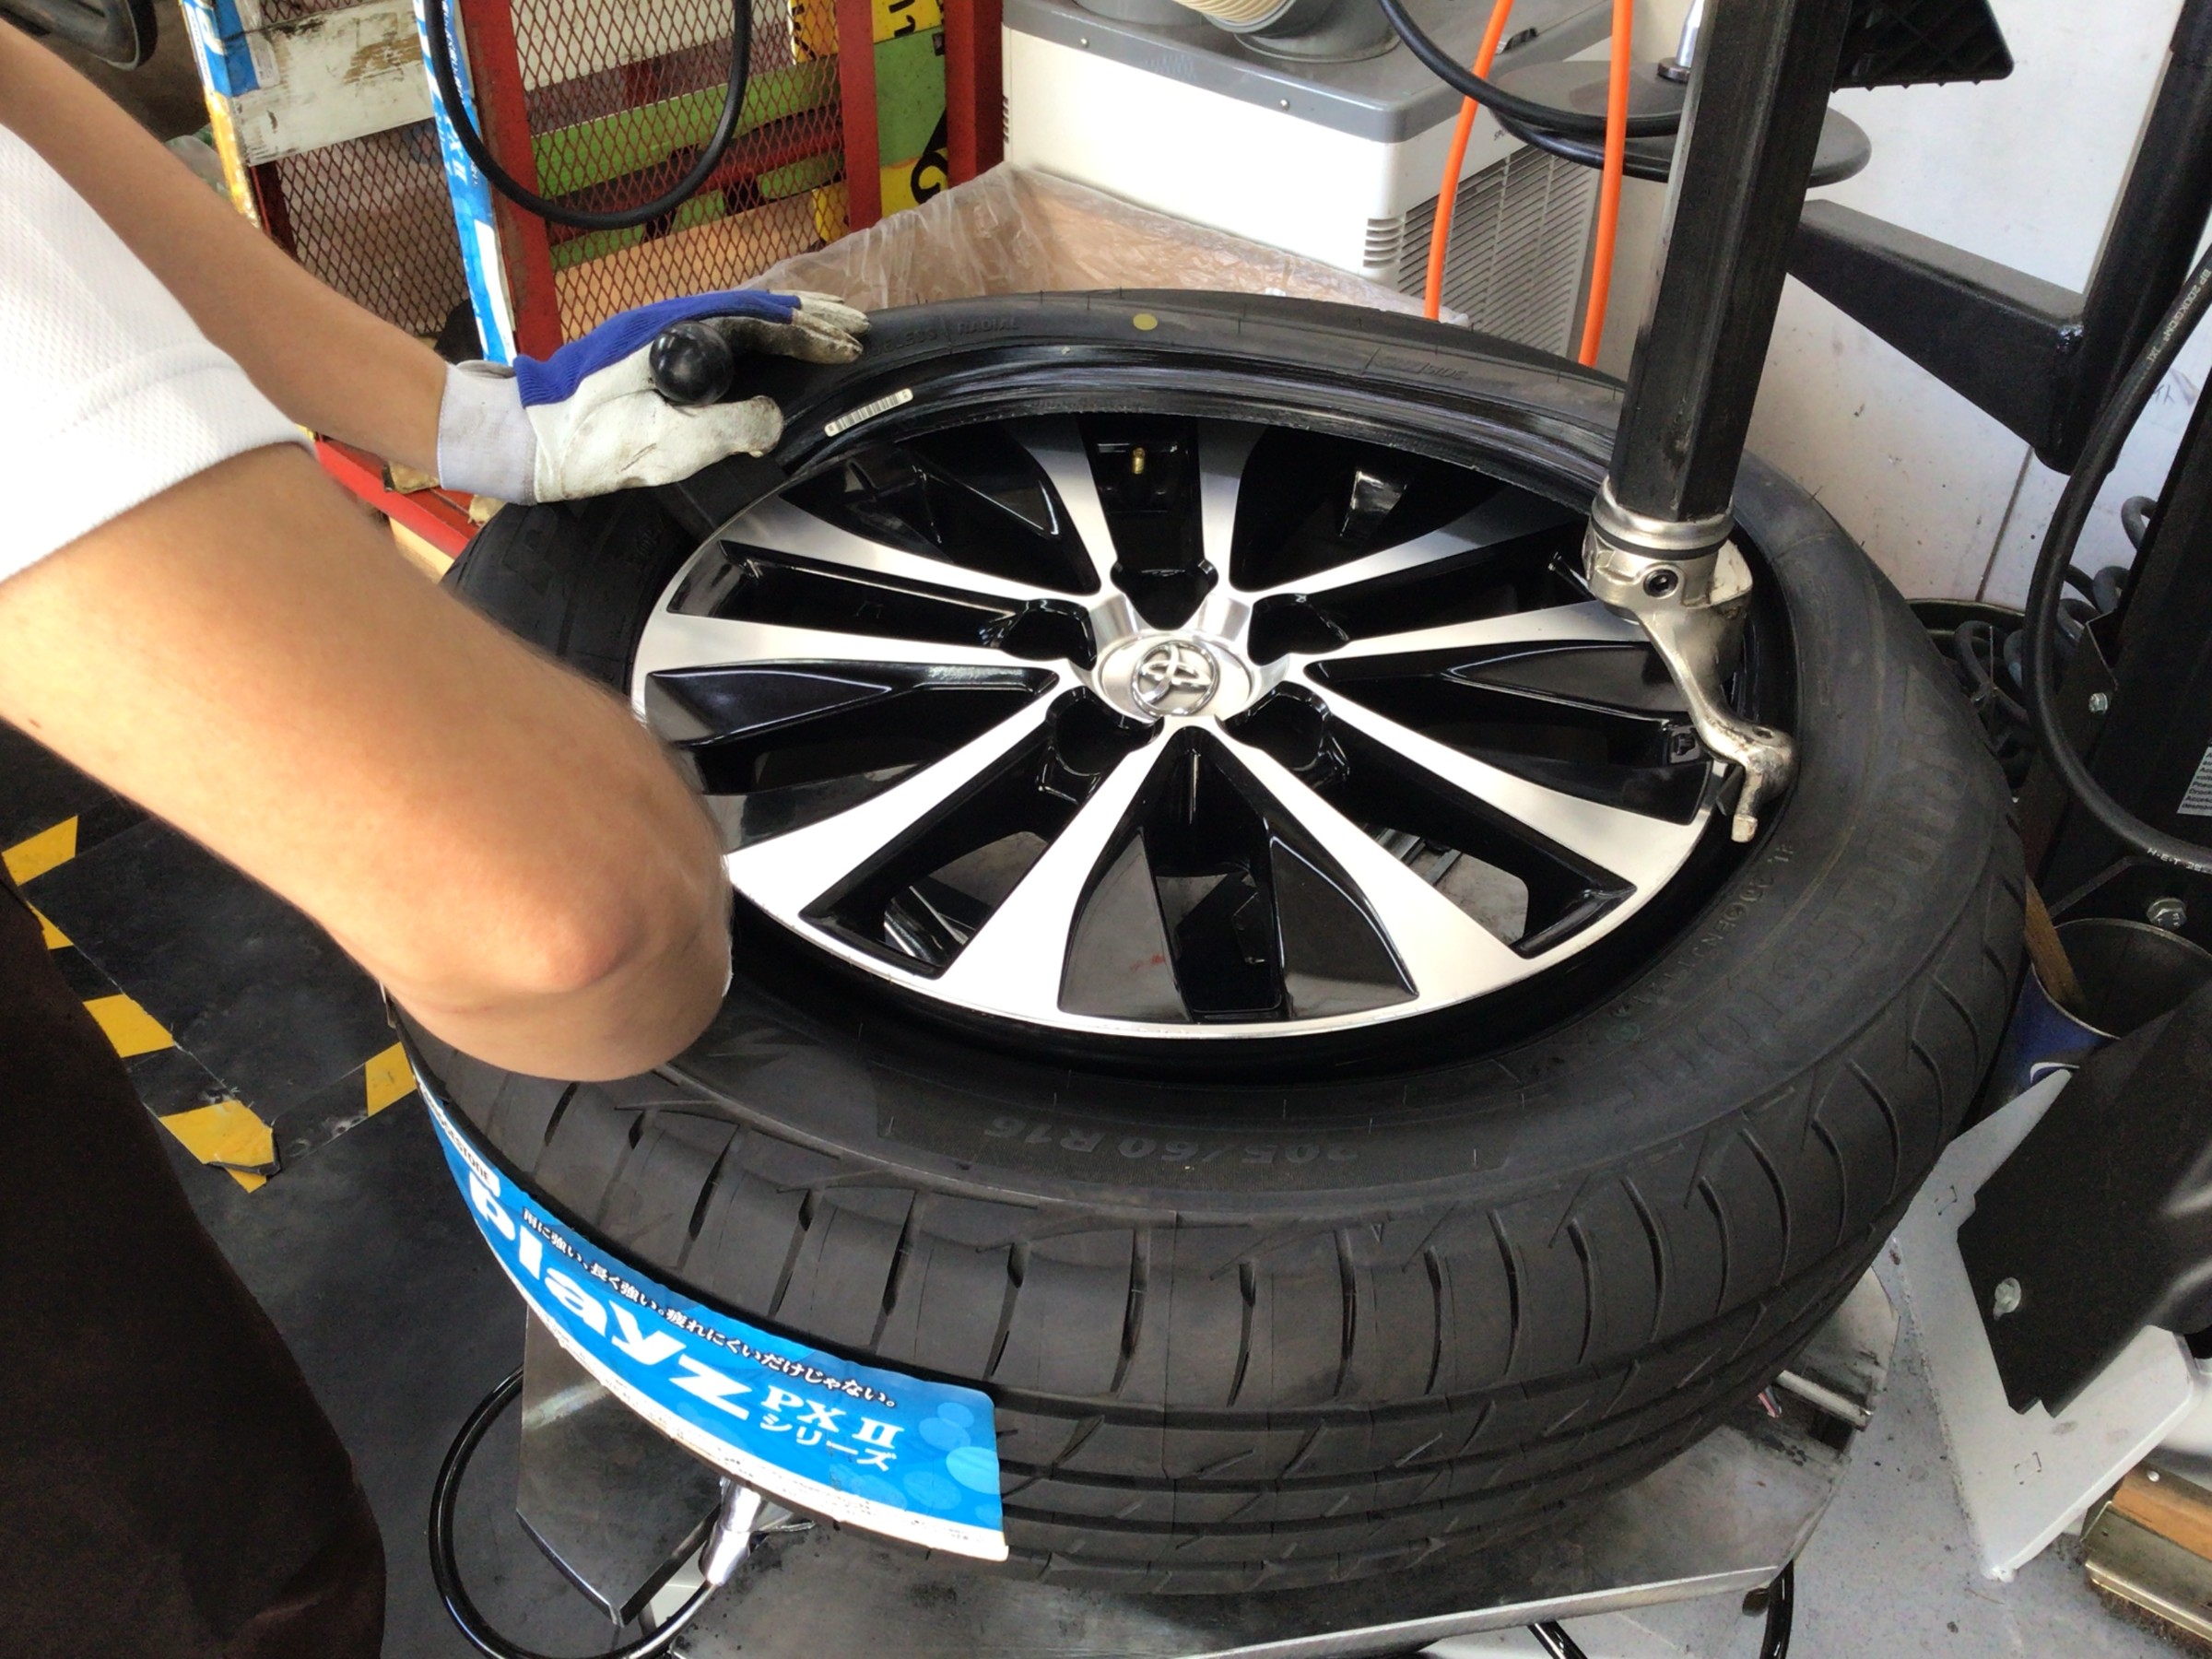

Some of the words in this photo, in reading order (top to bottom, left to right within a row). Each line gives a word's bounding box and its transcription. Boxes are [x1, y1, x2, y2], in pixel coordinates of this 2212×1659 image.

[760, 1384, 846, 1433] PX
[759, 1412, 898, 1472] シリーズ
